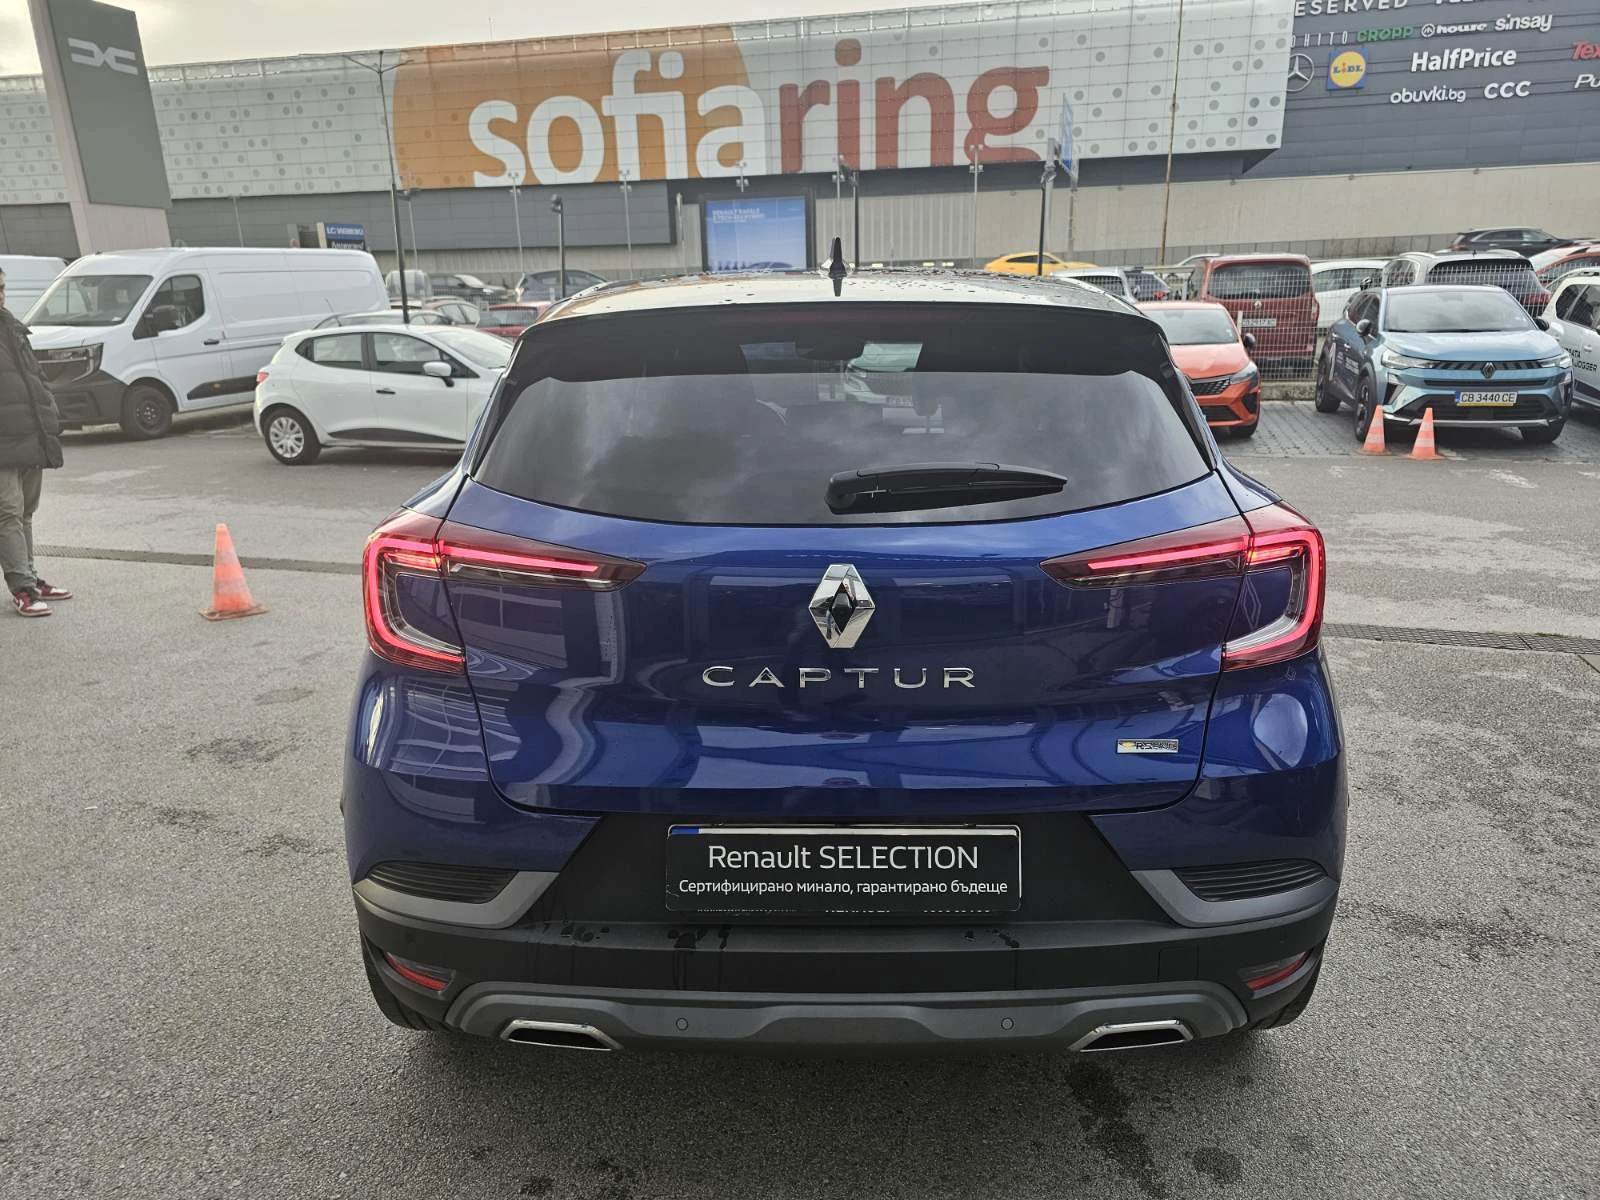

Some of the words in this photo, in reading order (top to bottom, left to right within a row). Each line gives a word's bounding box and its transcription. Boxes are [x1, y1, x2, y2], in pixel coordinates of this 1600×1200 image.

[1495, 14, 1553, 32] sinsay
[1357, 26, 1414, 42] CROPP
[1411, 48, 1517, 72] HalfPrice
[1390, 84, 1467, 103] obuvki.bg
[1484, 80, 1531, 99] CCC
[1461, 393, 1475, 403] CB
[1476, 393, 1501, 403] 3440
[1502, 393, 1516, 403] CE
[702, 665, 976, 689] CAPTUR
[709, 845, 812, 869] Renault
[819, 845, 979, 869] SELECTION
[679, 879, 794, 895] Сертифицирано
[796, 882, 854, 895] минало,
[856, 882, 948, 896] гарантирано
[950, 879, 1008, 895] бъдеще
